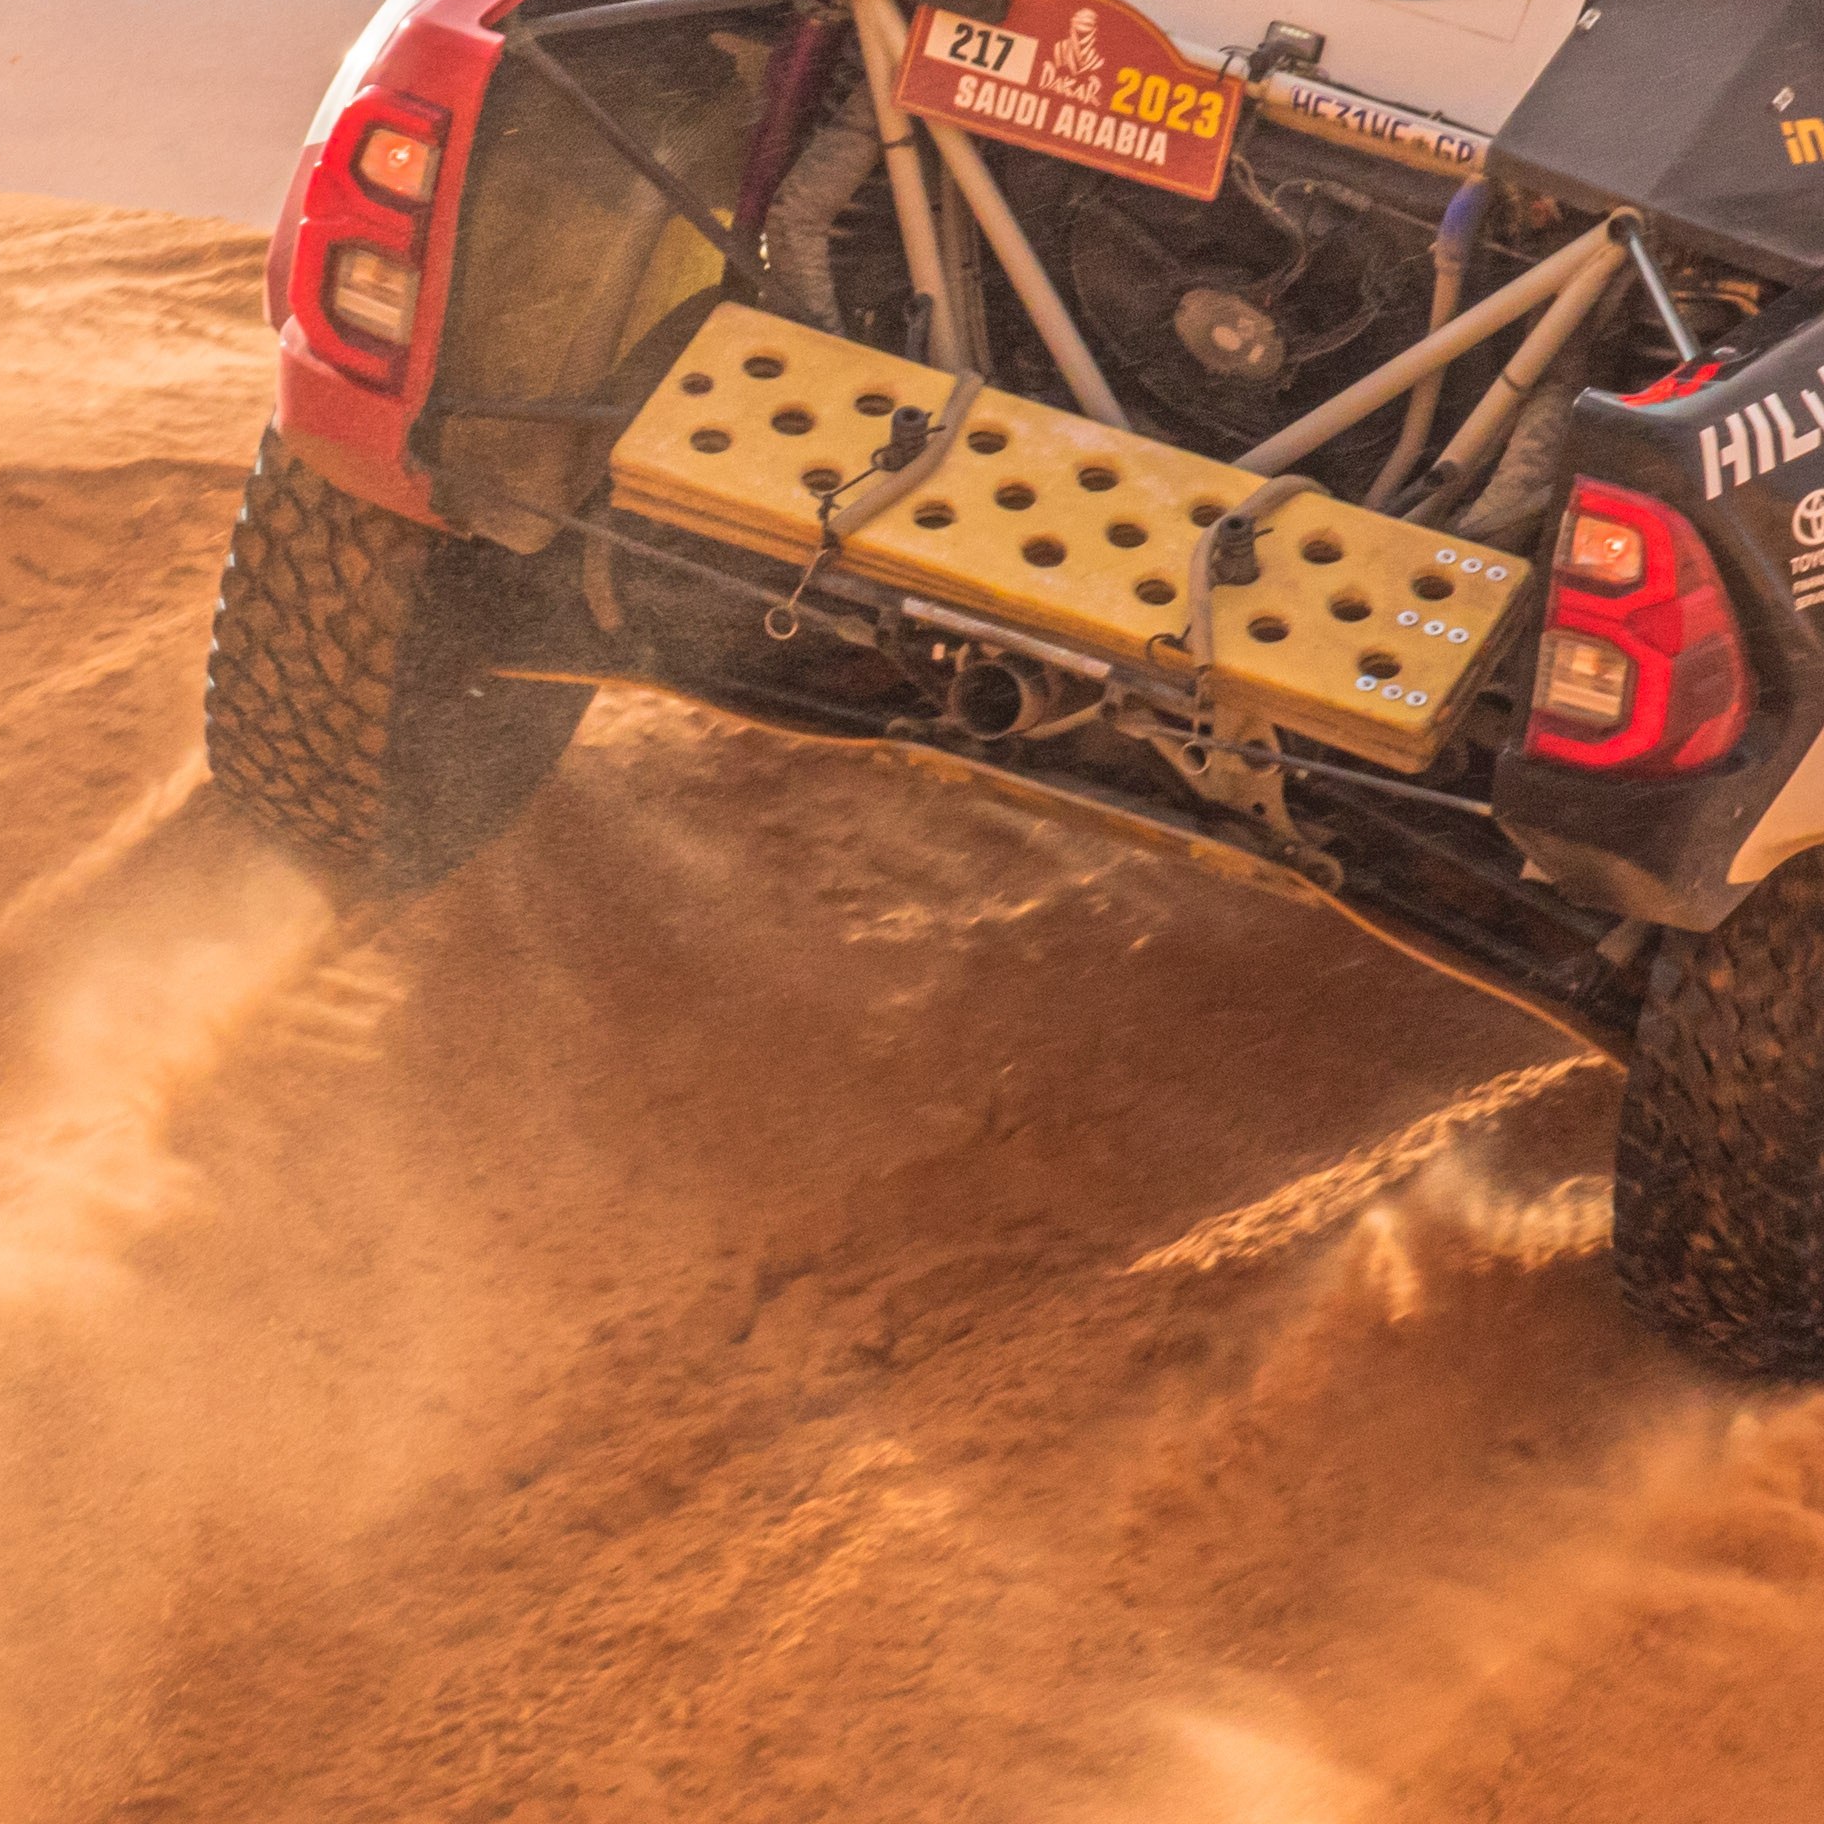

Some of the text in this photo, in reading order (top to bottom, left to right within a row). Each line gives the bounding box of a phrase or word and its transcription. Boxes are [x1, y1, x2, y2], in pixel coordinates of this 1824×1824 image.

[948, 21, 1016, 72] 217
[953, 74, 1168, 167] SAUDI ARABIA
[1108, 66, 1226, 140] 2023
